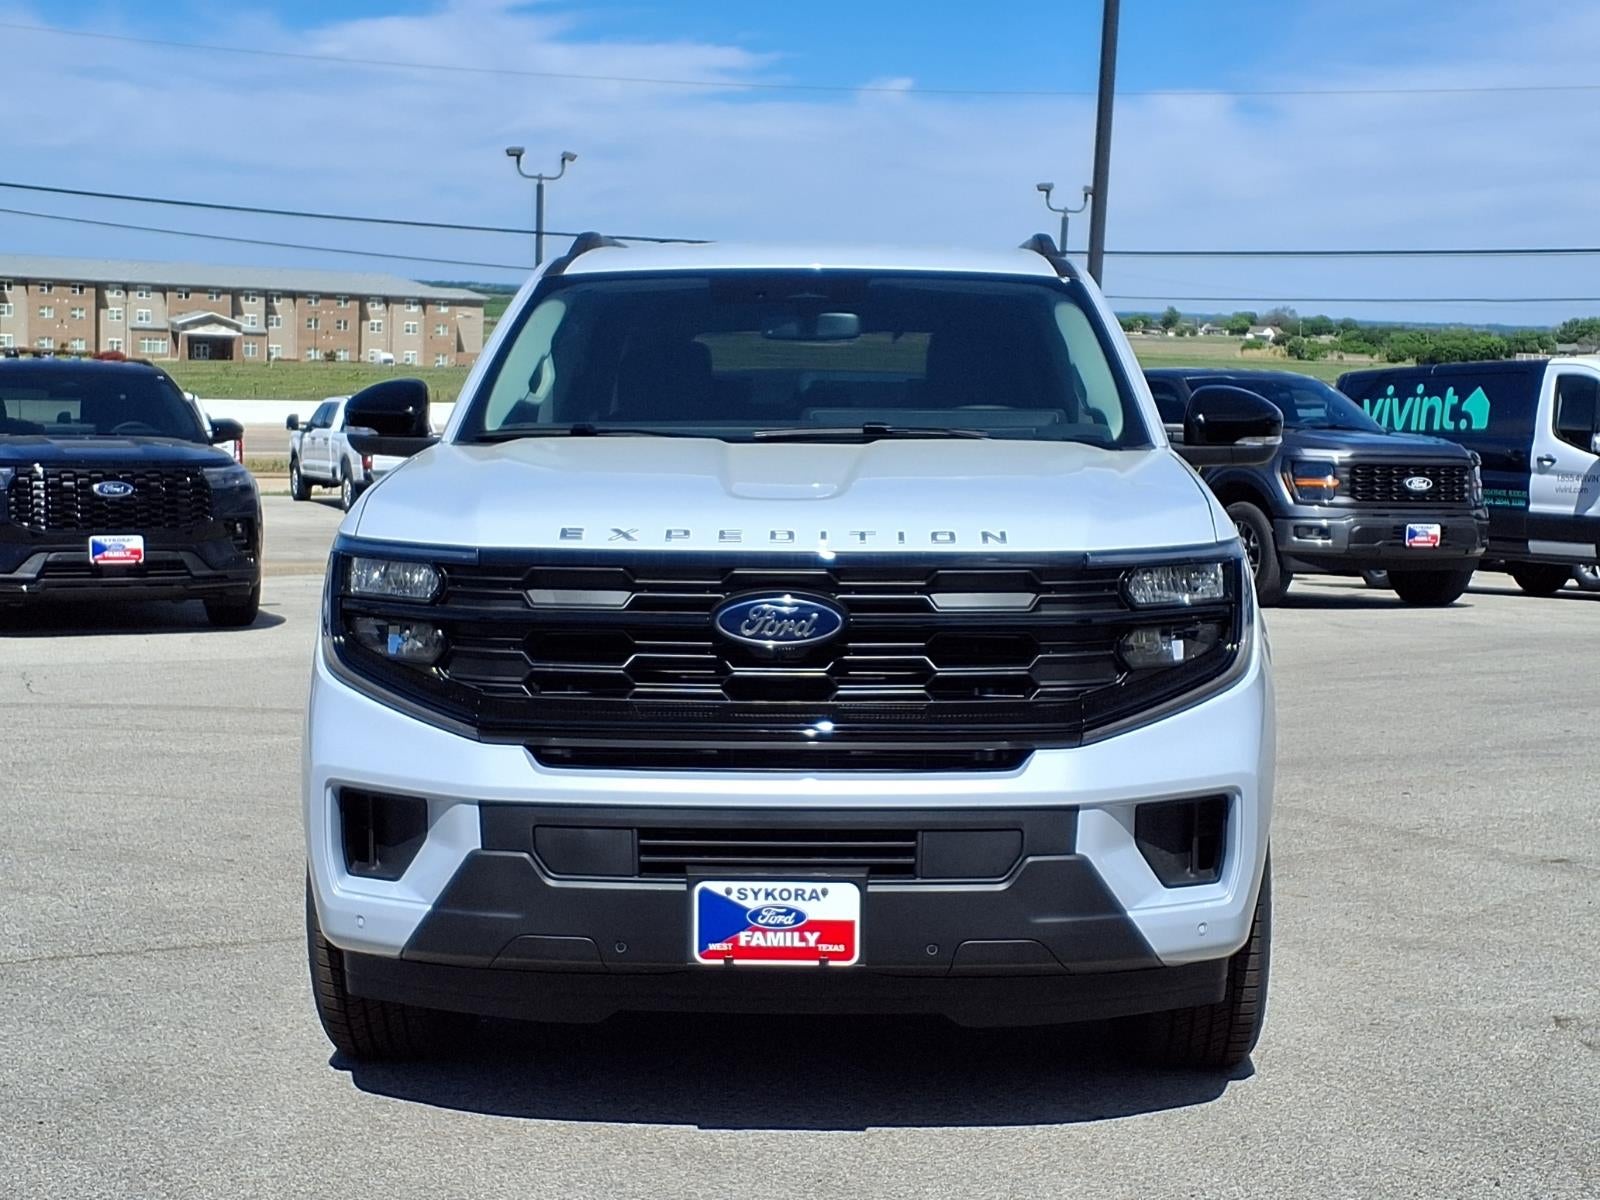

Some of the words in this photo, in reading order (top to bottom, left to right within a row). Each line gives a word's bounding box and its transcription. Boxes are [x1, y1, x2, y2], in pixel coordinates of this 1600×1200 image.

[558, 527, 1008, 545] EXPEDITION
[740, 603, 818, 637] Ford
[737, 887, 821, 901] SYKORA
[757, 907, 796, 925] Ford
[708, 943, 733, 951] WEST
[738, 931, 821, 948] FAMILY
[817, 944, 846, 953] TEXAS
